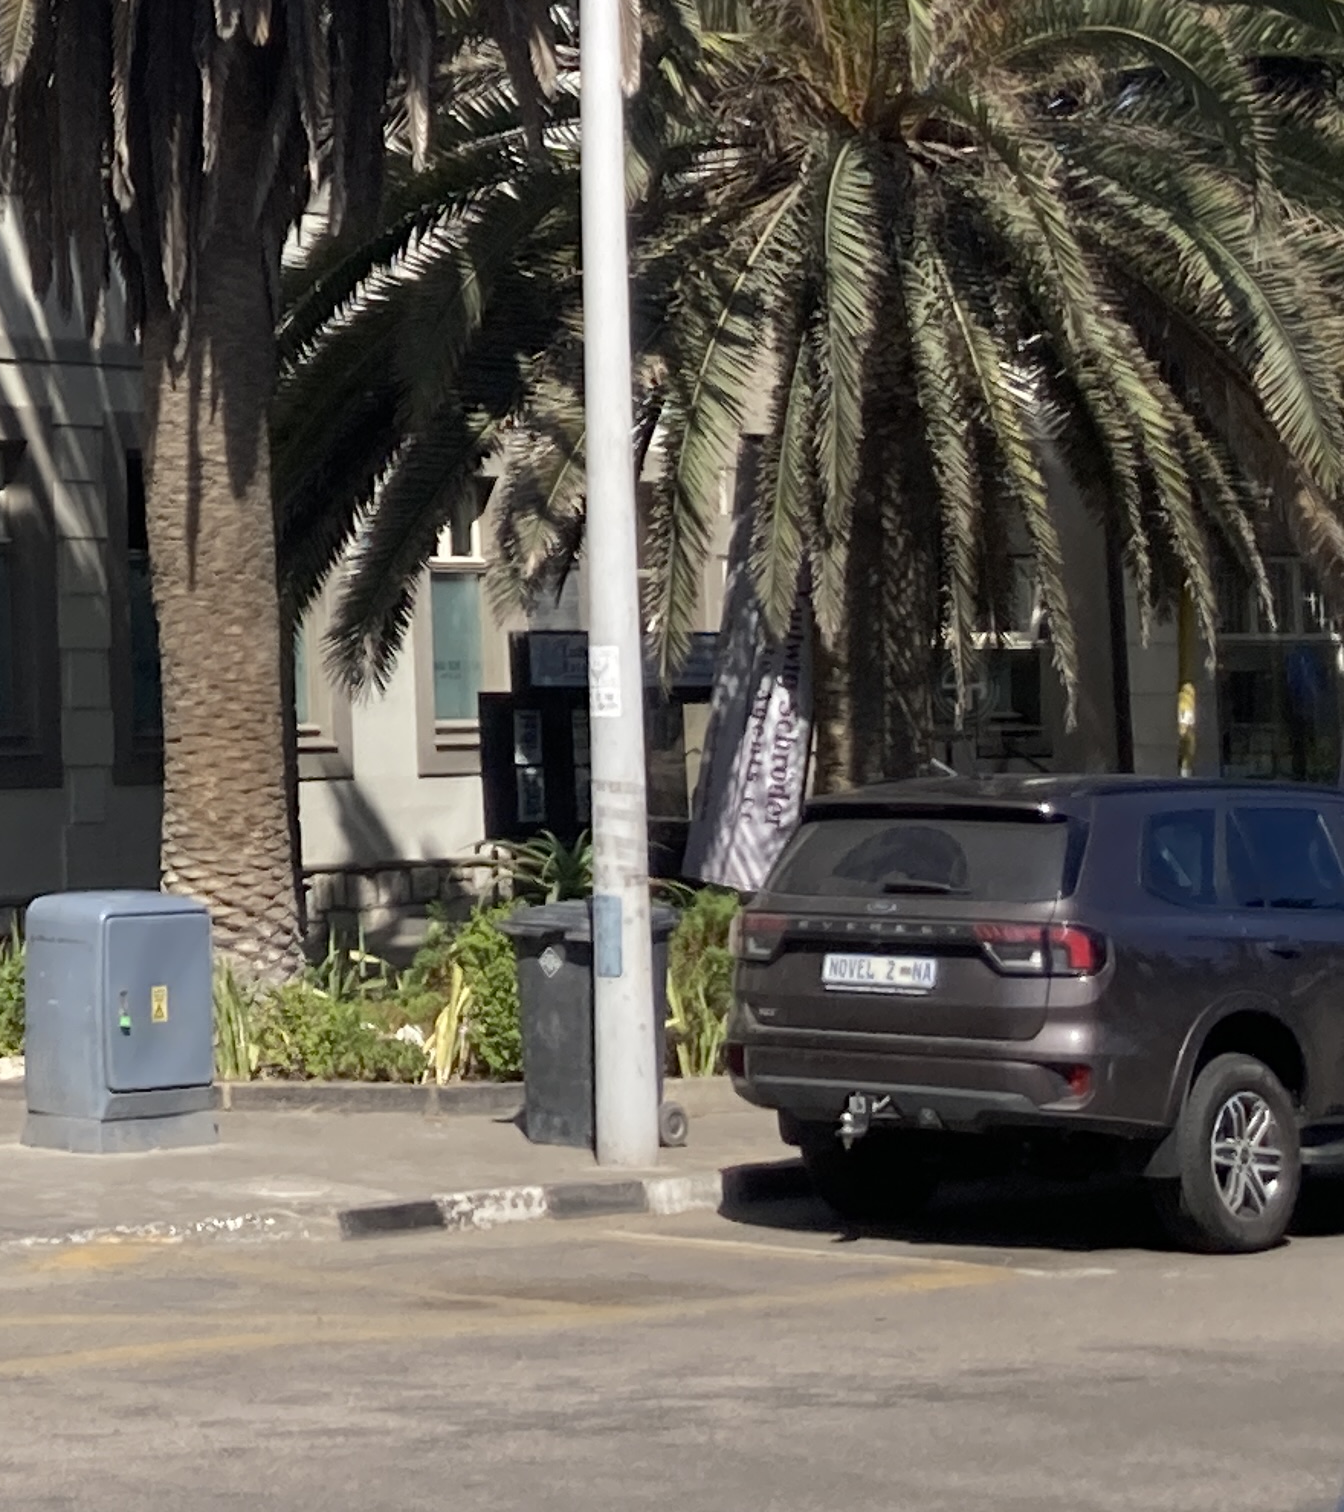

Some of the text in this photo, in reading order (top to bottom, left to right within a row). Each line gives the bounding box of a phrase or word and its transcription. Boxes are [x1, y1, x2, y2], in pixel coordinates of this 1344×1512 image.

[828, 956, 933, 982] NOVEL 2 NA
